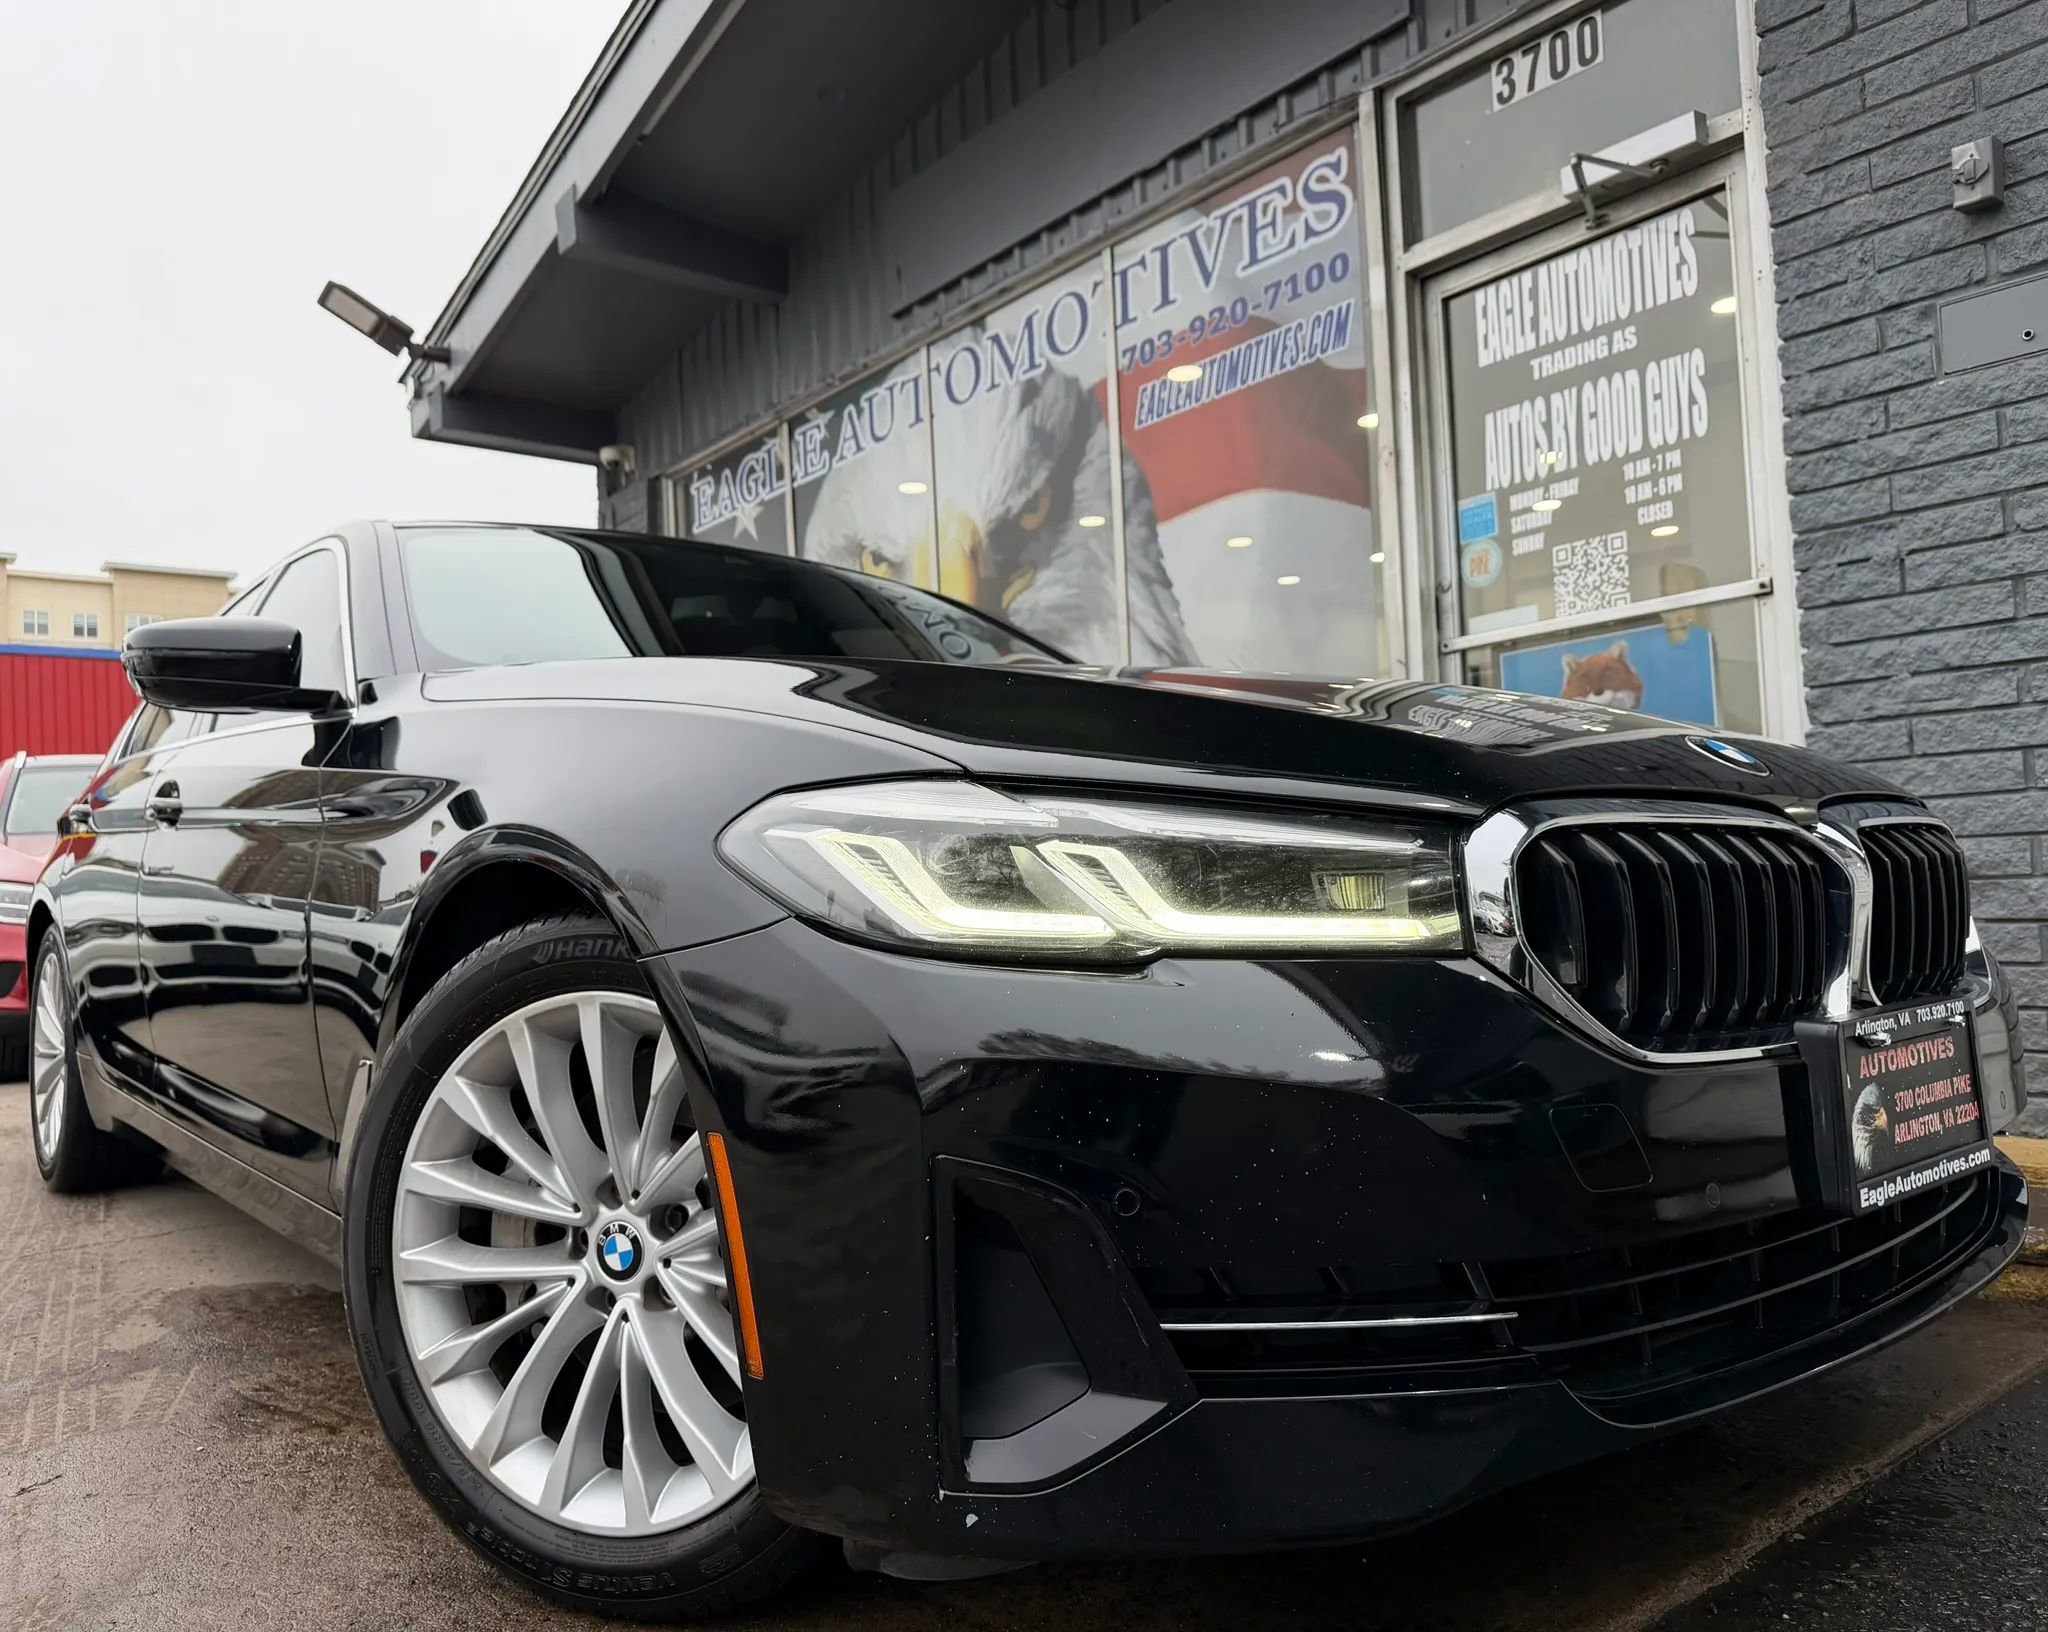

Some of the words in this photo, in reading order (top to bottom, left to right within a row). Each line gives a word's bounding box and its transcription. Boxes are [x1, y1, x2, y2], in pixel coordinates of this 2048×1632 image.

[1494, 16, 1599, 106] 3700
[1121, 252, 1350, 373] 703-920-7100
[1475, 270, 1536, 368] EAGLE
[1537, 207, 1698, 347] AUTOMOTIVES
[692, 422, 829, 533] EAGLE
[833, 147, 1353, 471] AUTOMOTIVES
[1134, 299, 1355, 429] EAGLEAUTOMOTIVES.COM
[1530, 335, 1608, 380] TRADING
[1612, 325, 1637, 353] AS
[1485, 396, 1550, 491] AUTOS
[1551, 386, 1578, 474] BY
[1582, 369, 1643, 466] GOOD
[1645, 348, 1708, 449] GUYS
[1637, 500, 1674, 525] CLOSED
[1855, 1015, 1897, 1037] Arlington,
[1898, 1012, 1911, 1028] VA
[1916, 1001, 1965, 1023] 703.920.7100
[1859, 1036, 1955, 1079] AUTOMOTIVES
[1894, 1092, 1914, 1112] 3700
[1915, 1080, 1952, 1106] COLUMBIA
[1953, 1074, 1972, 1097] PIKE
[1894, 1115, 1943, 1144] ARLINGTON,
[1943, 1109, 1956, 1128] VA
[1956, 1101, 1980, 1124] 22204
[1859, 1148, 1991, 1208] EagleAutomotives.com
[598, 1223, 637, 1247] BMW
